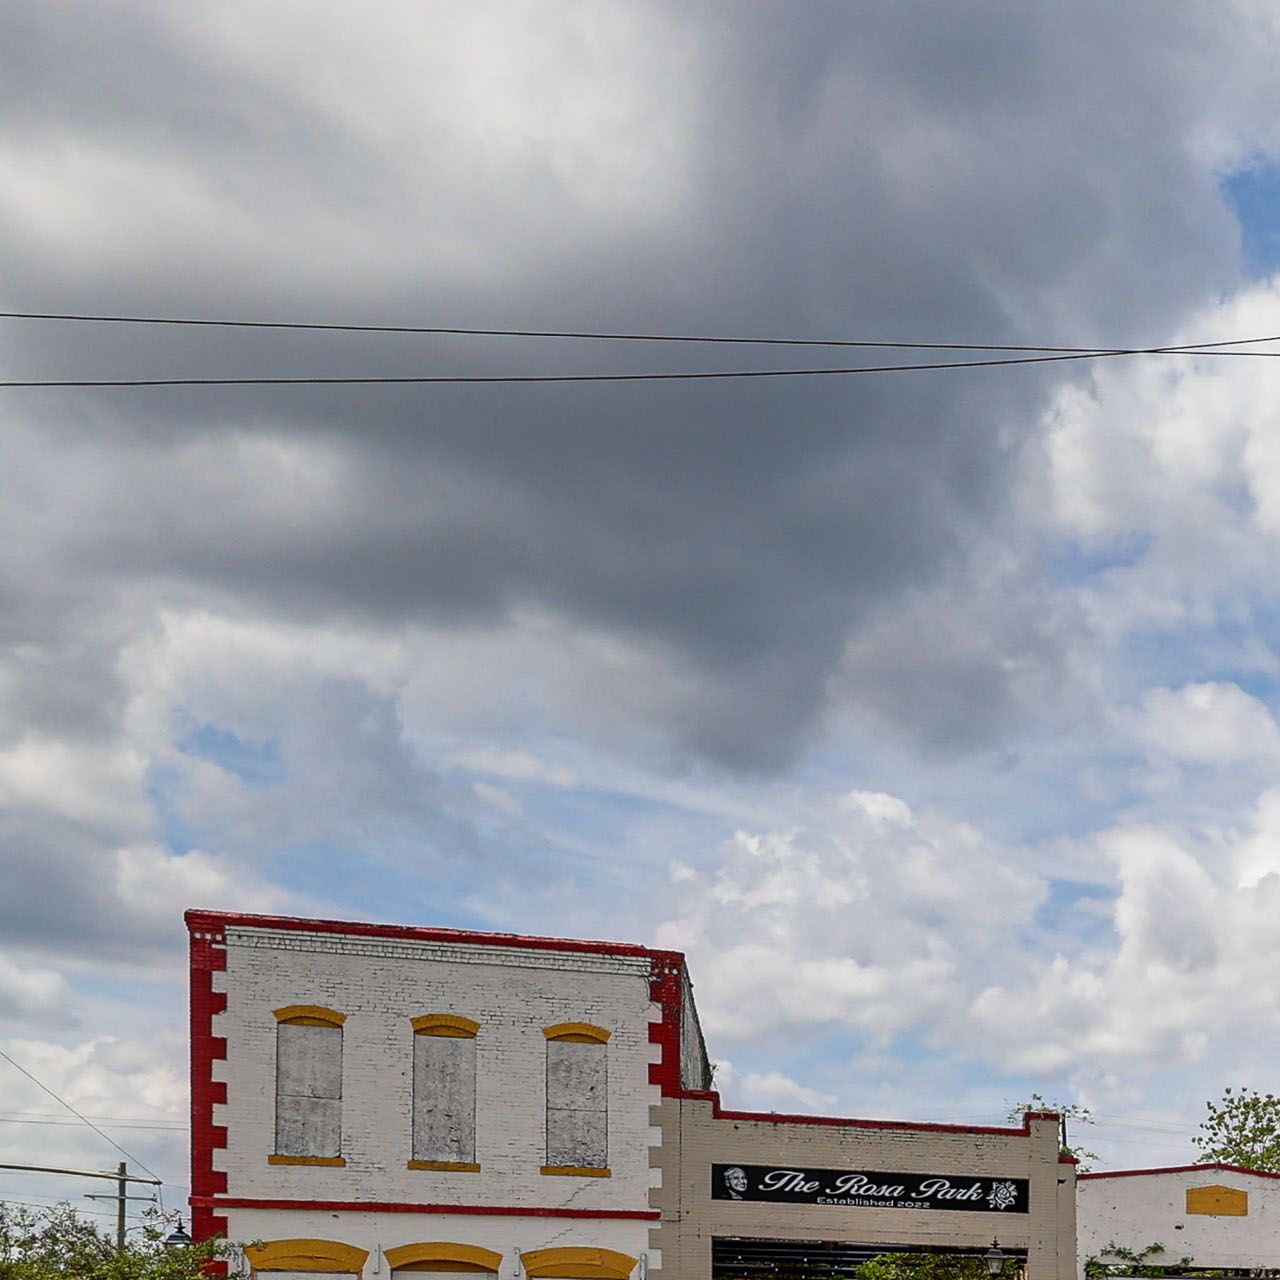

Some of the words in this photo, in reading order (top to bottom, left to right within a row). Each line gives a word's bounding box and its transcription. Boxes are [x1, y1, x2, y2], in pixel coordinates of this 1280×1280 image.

[758, 1170, 820, 1193] The
[825, 1174, 905, 1197] Rosa
[910, 1178, 984, 1200] Park
[817, 1196, 894, 1208] Established
[897, 1200, 931, 1209] 2022
